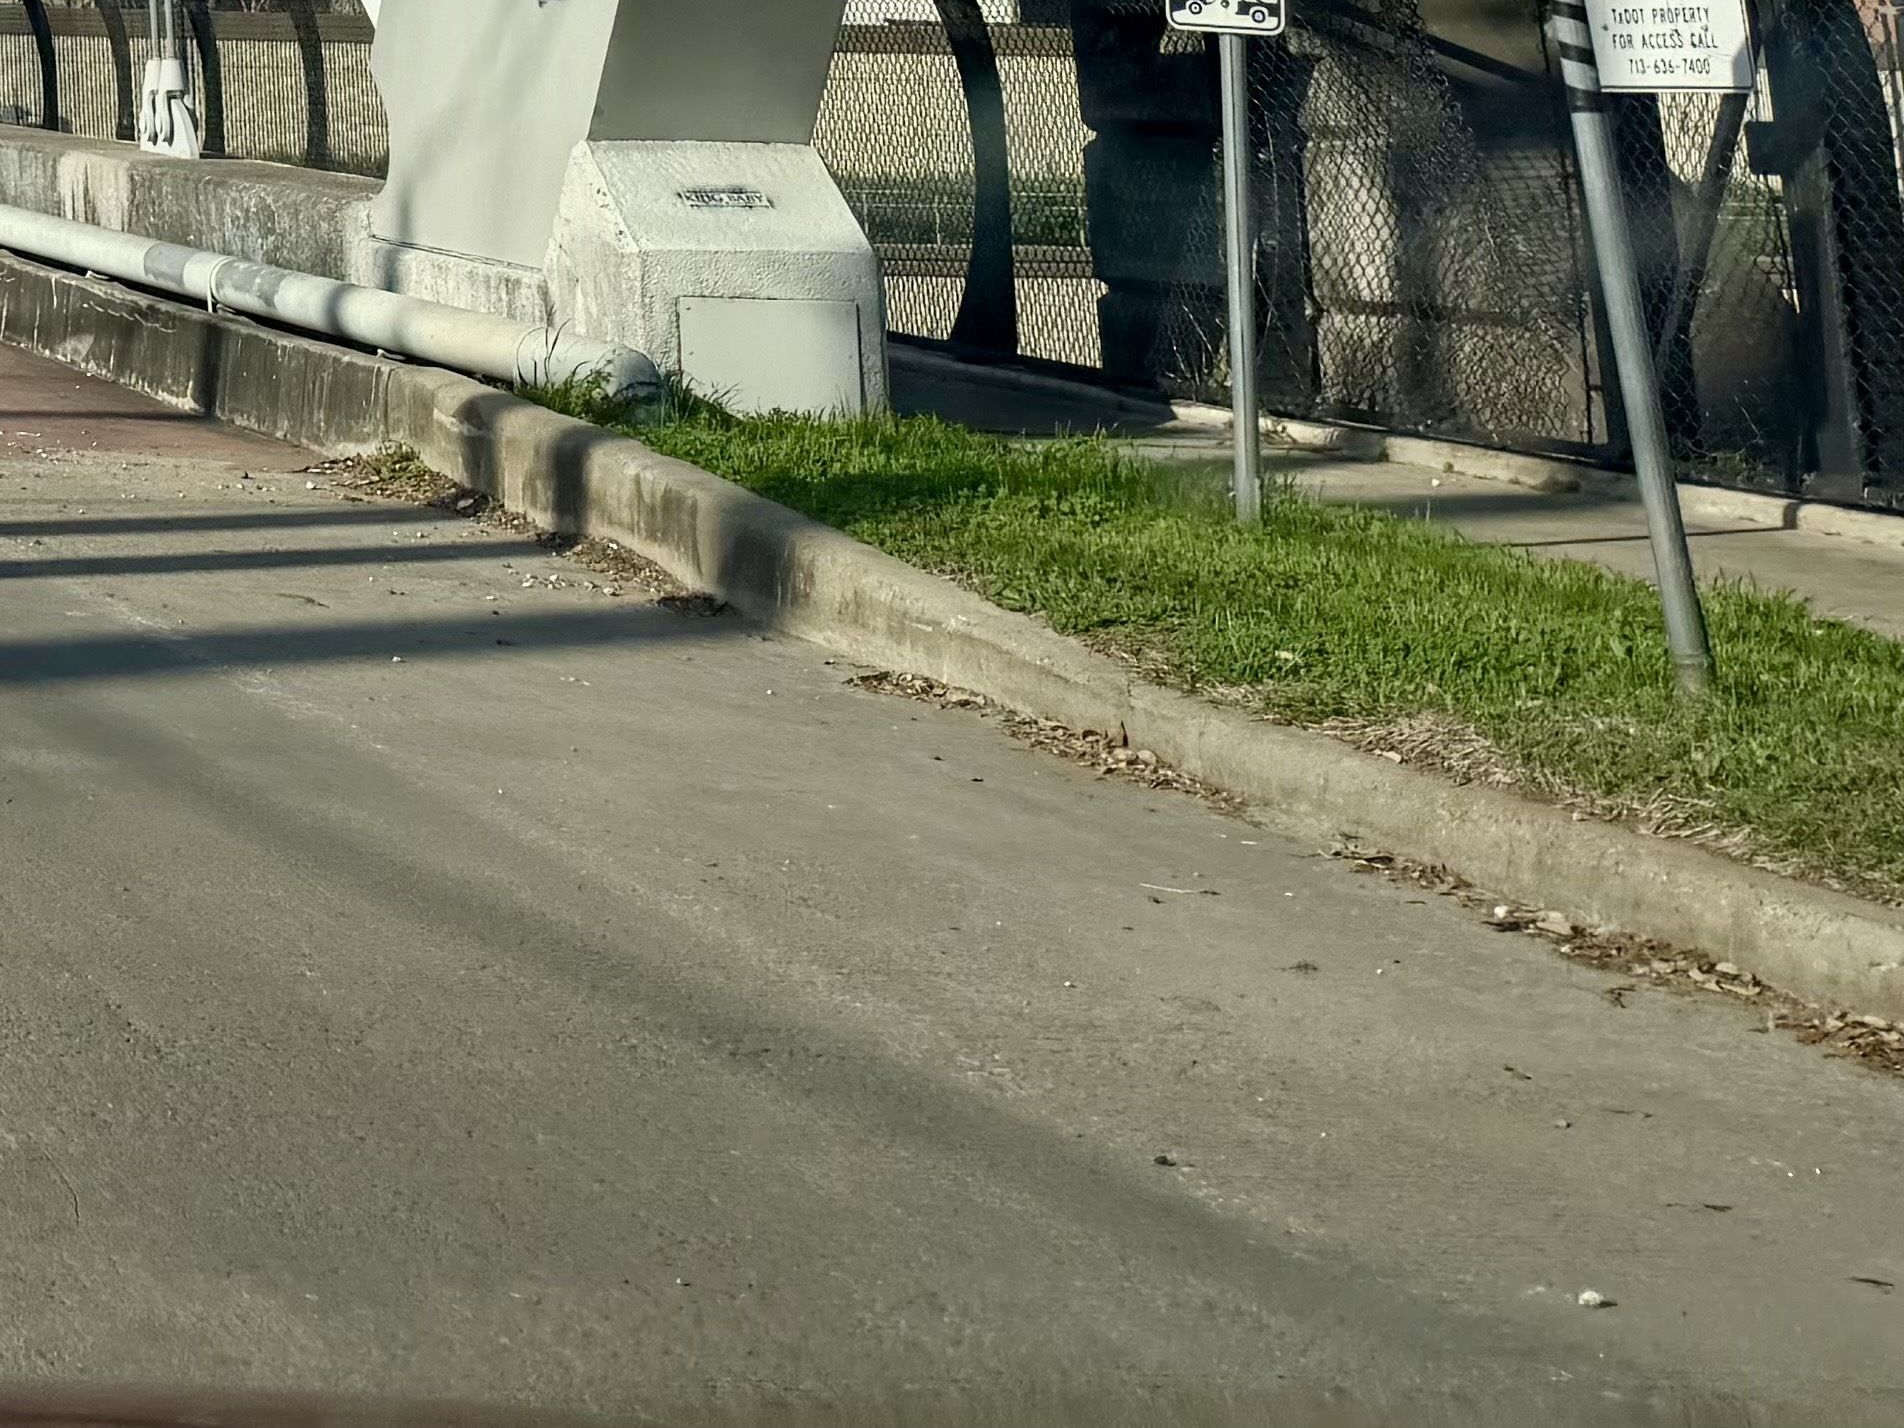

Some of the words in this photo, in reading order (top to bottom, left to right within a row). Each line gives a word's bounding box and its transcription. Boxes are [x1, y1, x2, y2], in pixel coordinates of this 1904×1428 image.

[1652, 7, 1710, 25] PROPERTY
[1613, 33, 1635, 50] FOR
[1642, 32, 1684, 49] ACCESS
[1691, 33, 1719, 49] CALL
